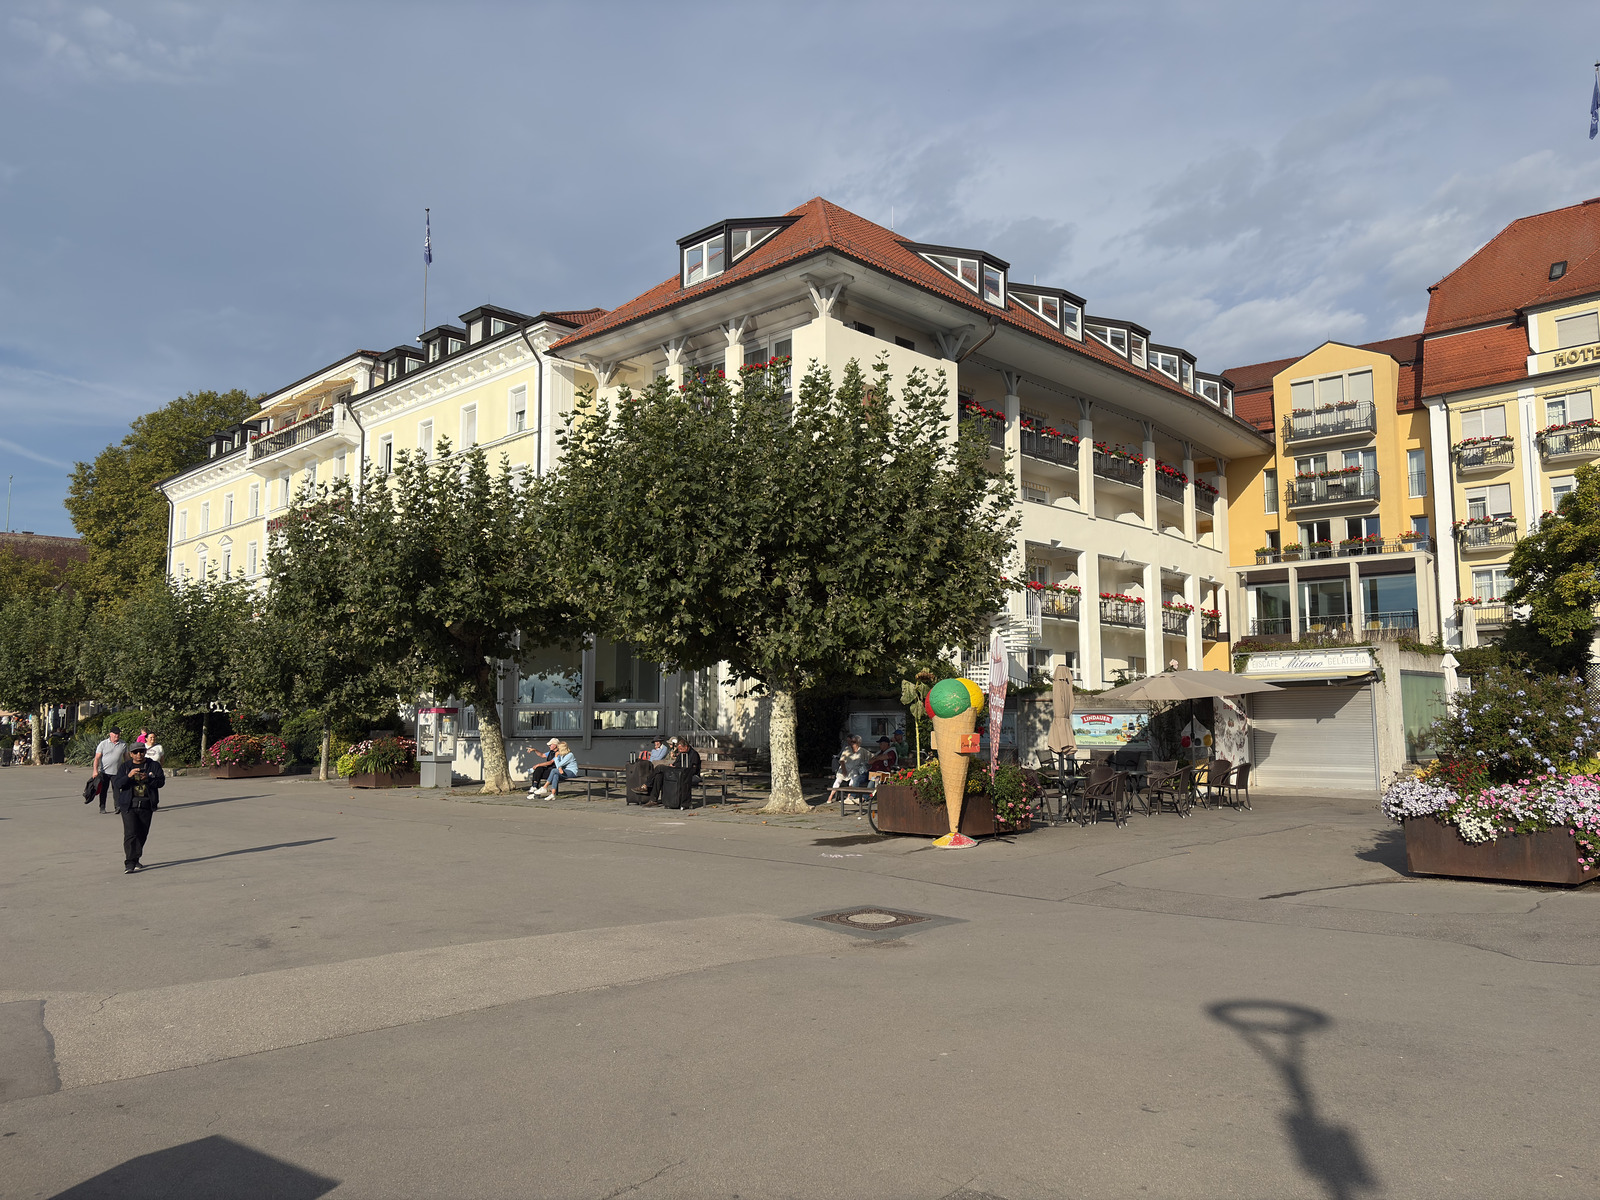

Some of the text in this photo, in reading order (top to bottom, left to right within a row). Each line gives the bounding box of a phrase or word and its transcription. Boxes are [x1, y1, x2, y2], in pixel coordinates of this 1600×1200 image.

[1282, 654, 1323, 669] Milano
[1327, 655, 1367, 665] GELATERIA
[1083, 714, 1111, 723] LINDAUER
